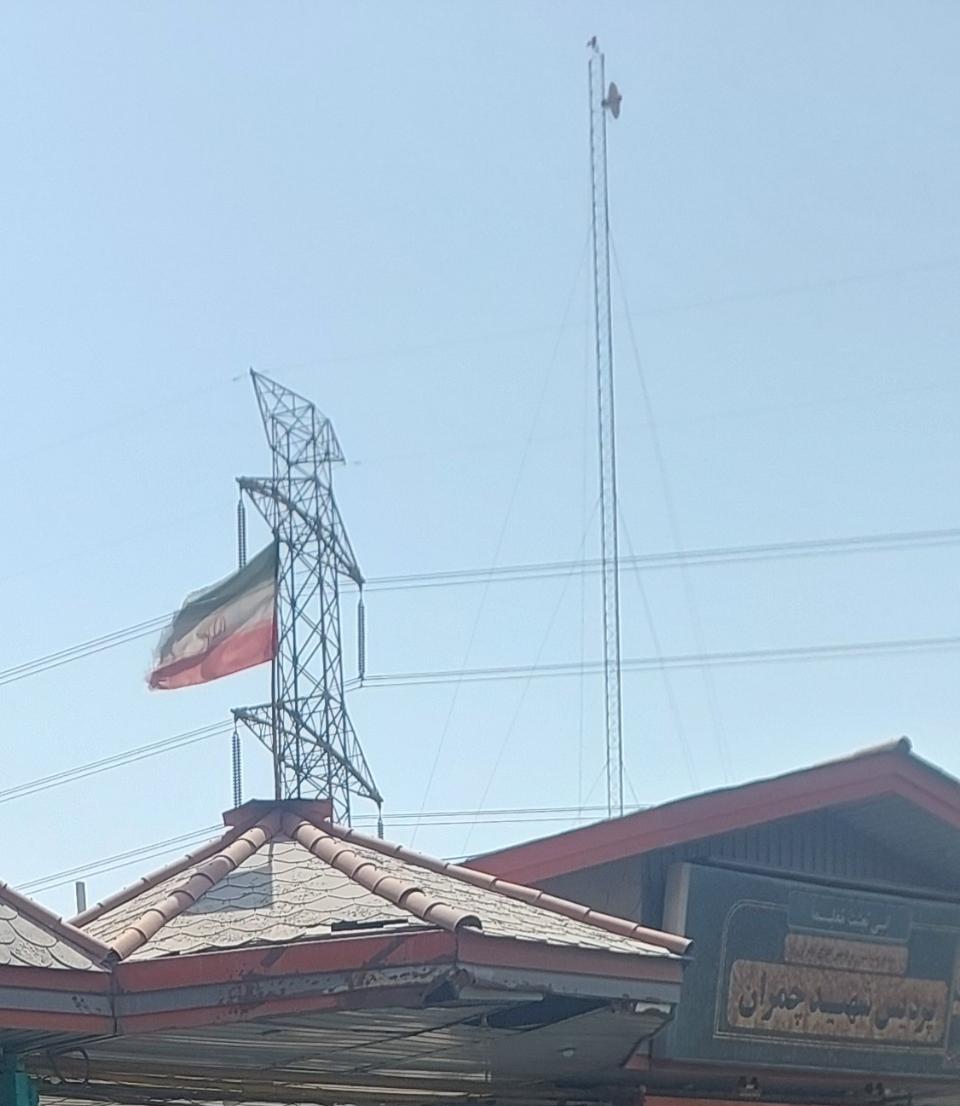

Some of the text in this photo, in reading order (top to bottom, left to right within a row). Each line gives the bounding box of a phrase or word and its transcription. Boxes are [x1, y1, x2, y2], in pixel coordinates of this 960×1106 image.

[738, 970, 937, 1034] پردیس شهید چمران
